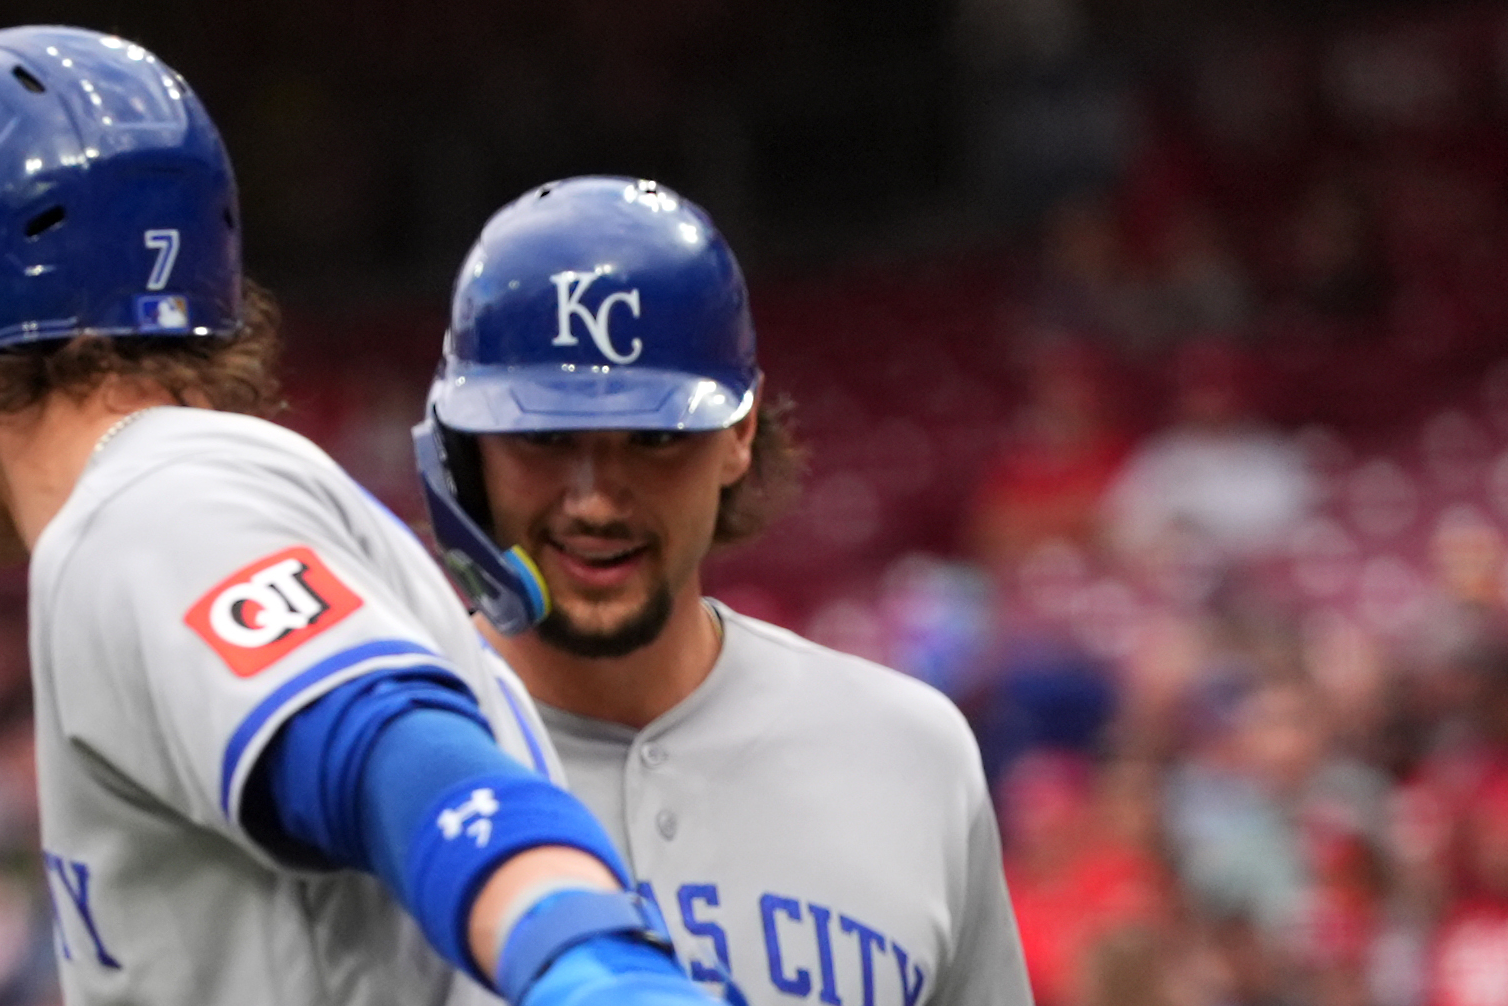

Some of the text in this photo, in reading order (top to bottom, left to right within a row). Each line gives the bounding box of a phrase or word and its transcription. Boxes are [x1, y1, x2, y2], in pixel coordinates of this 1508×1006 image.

[144, 229, 180, 291] 7
[549, 271, 643, 365] KC
[209, 556, 330, 649] QT
